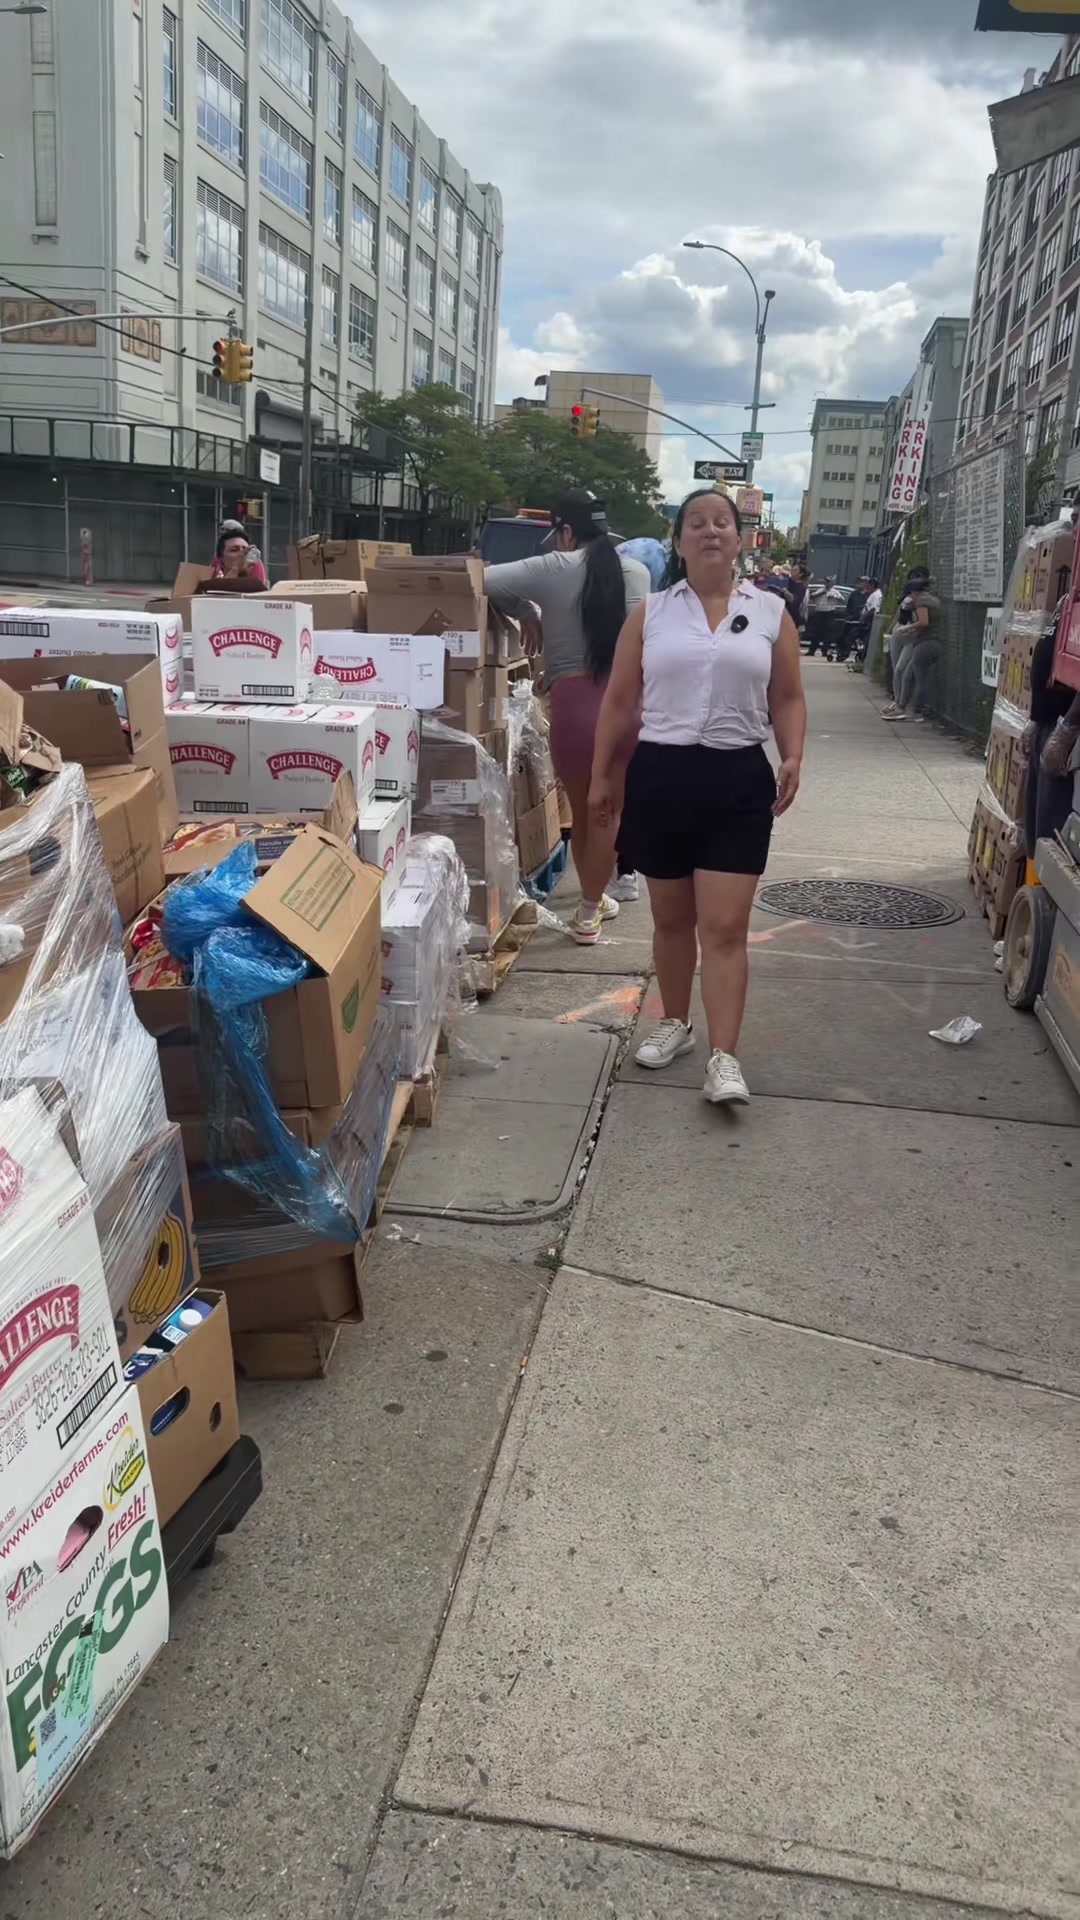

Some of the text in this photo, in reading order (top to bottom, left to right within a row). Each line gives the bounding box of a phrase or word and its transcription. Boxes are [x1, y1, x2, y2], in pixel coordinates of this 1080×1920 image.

[724, 466, 740, 476] WAY
[264, 602, 283, 610] GRADE
[213, 631, 277, 651] CHALLENGE
[317, 662, 374, 681] CHALLENGE
[238, 718, 246, 726] AA
[325, 724, 345, 733] GRADE
[171, 746, 230, 767] HALLENGE
[270, 754, 338, 775] CHALLENGE
[57, 1200, 80, 1229] GRADE
[0, 1296, 75, 1374] ALLENGE
[0, 1411, 130, 1559] www.kreiderfarms.com
[108, 1486, 147, 1551] Fresh!
[7, 1574, 45, 1622] Preferred
[6, 1615, 65, 1686] Lancaster
[66, 1544, 106, 1618] County
[7, 1519, 162, 1773] EGGS
